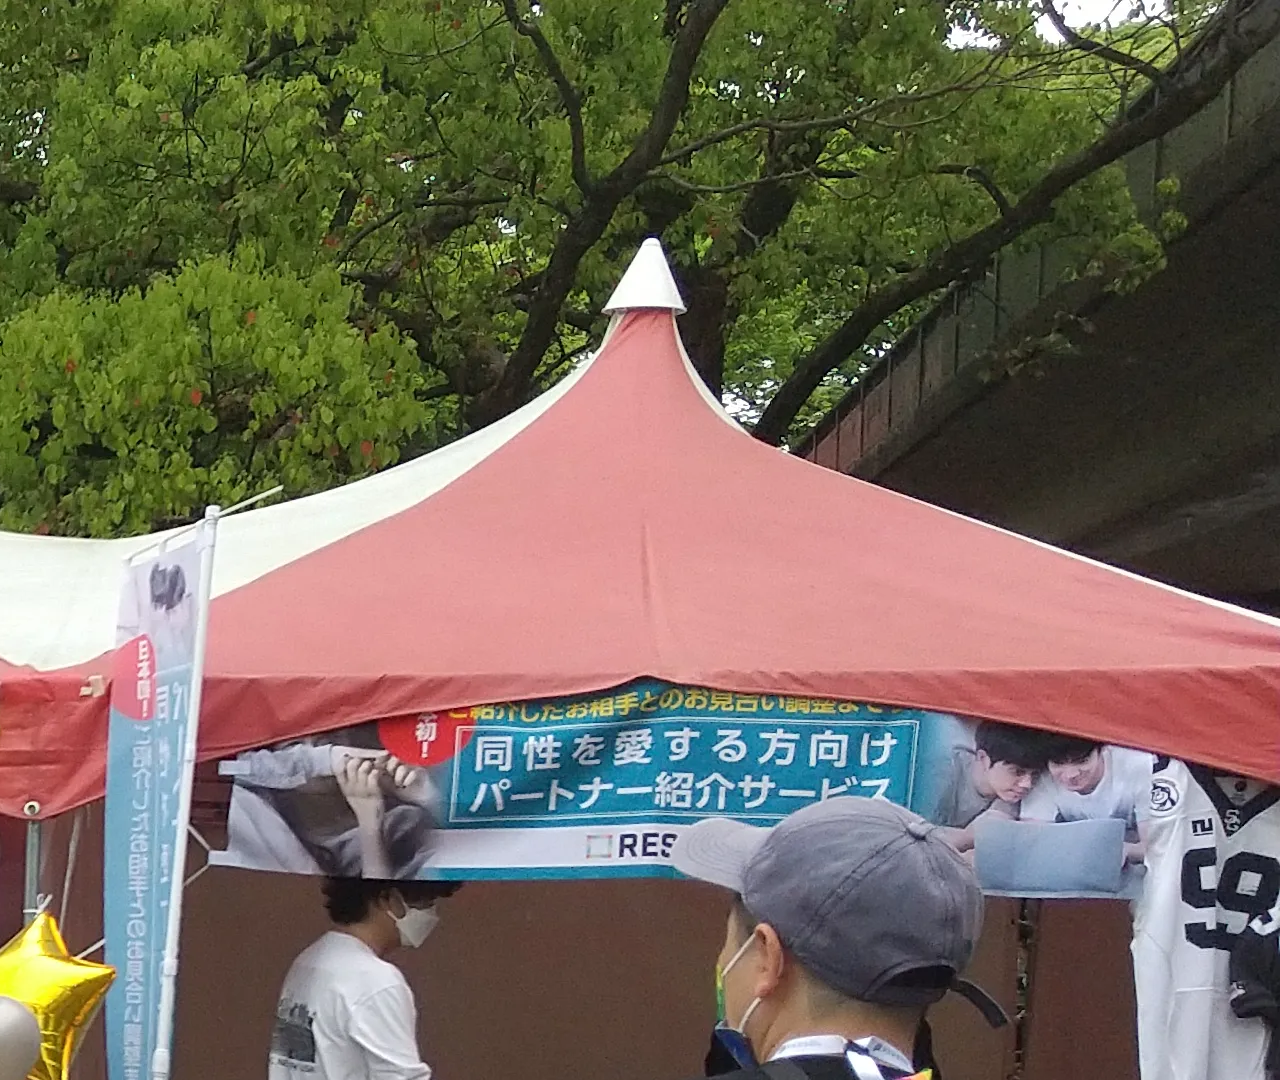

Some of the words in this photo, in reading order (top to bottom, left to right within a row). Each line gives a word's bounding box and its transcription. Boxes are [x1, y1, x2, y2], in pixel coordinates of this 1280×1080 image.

[475, 727, 898, 772] 同性を愛する方向け
[469, 771, 890, 813] パートナー紹介サービス
[618, 833, 678, 858] RES
